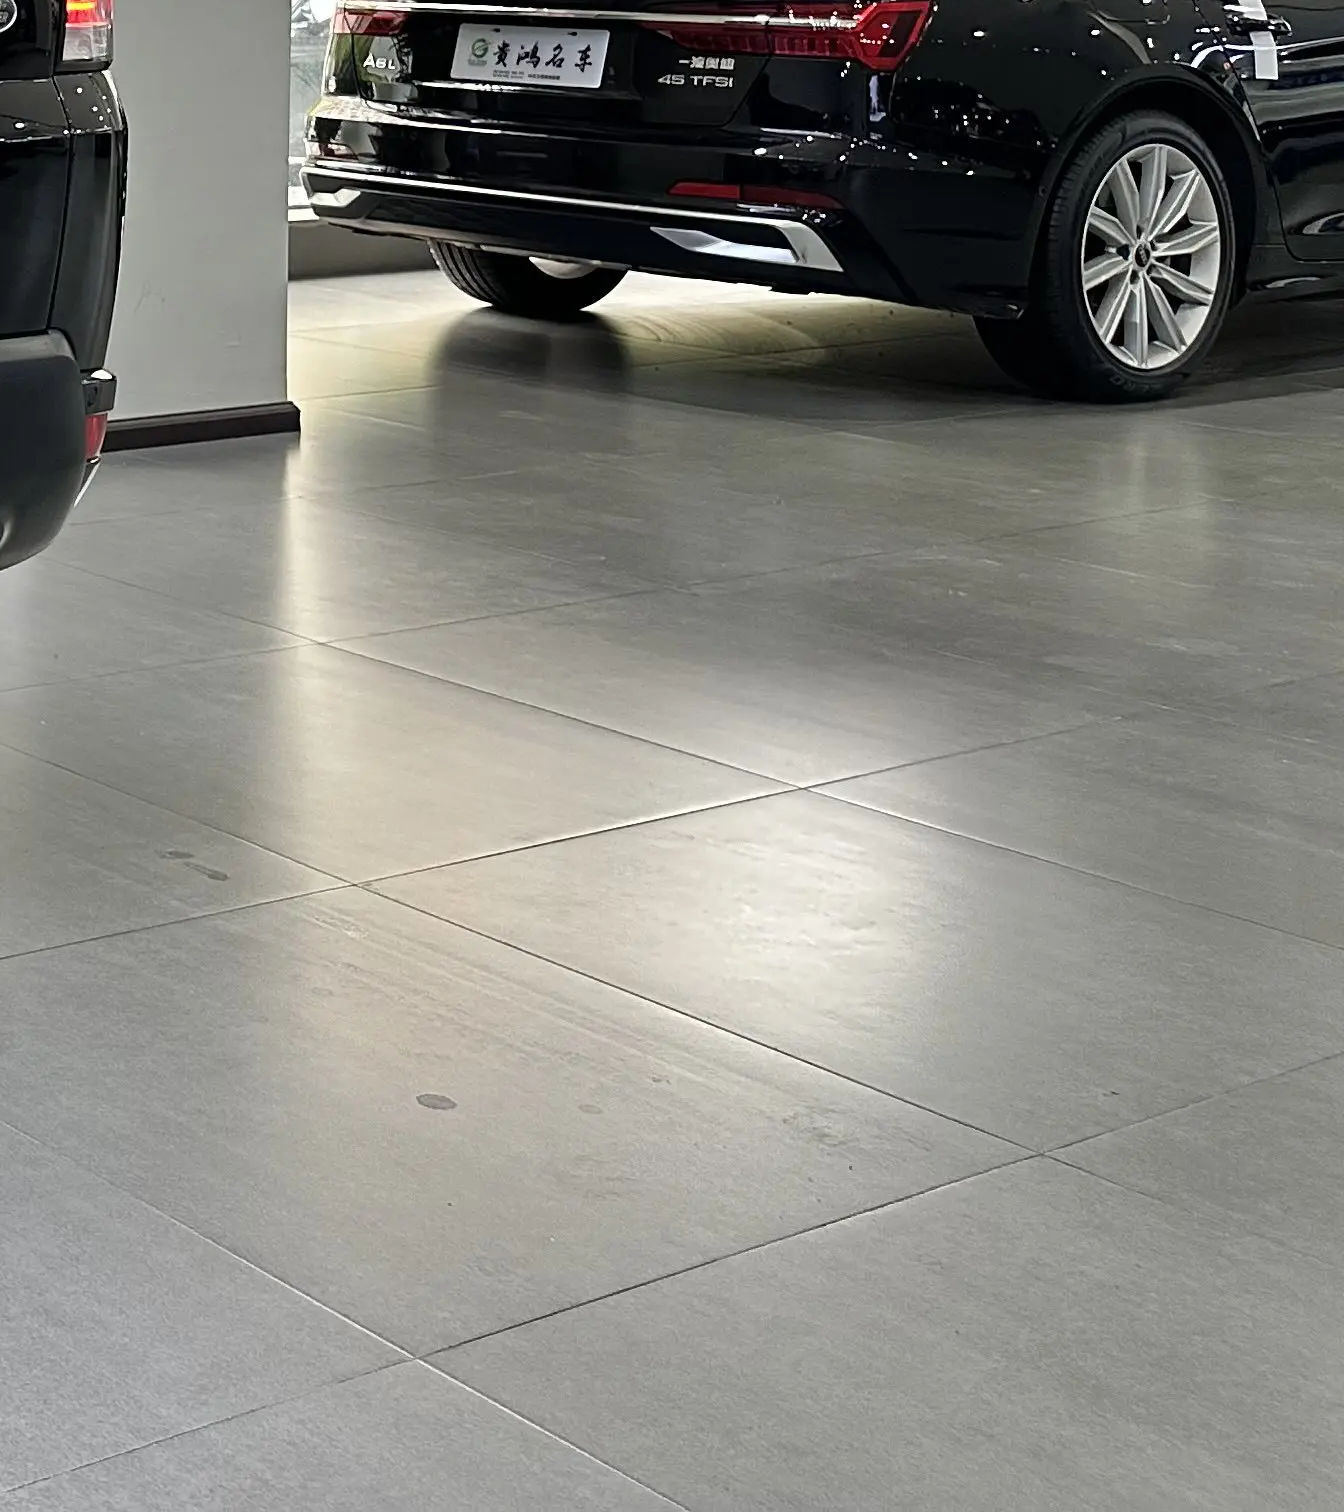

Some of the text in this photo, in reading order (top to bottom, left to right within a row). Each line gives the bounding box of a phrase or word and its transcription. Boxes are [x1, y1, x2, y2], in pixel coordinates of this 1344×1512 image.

[493, 40, 593, 73] 贵鸿名车
[657, 74, 734, 88] 45 TFSI
